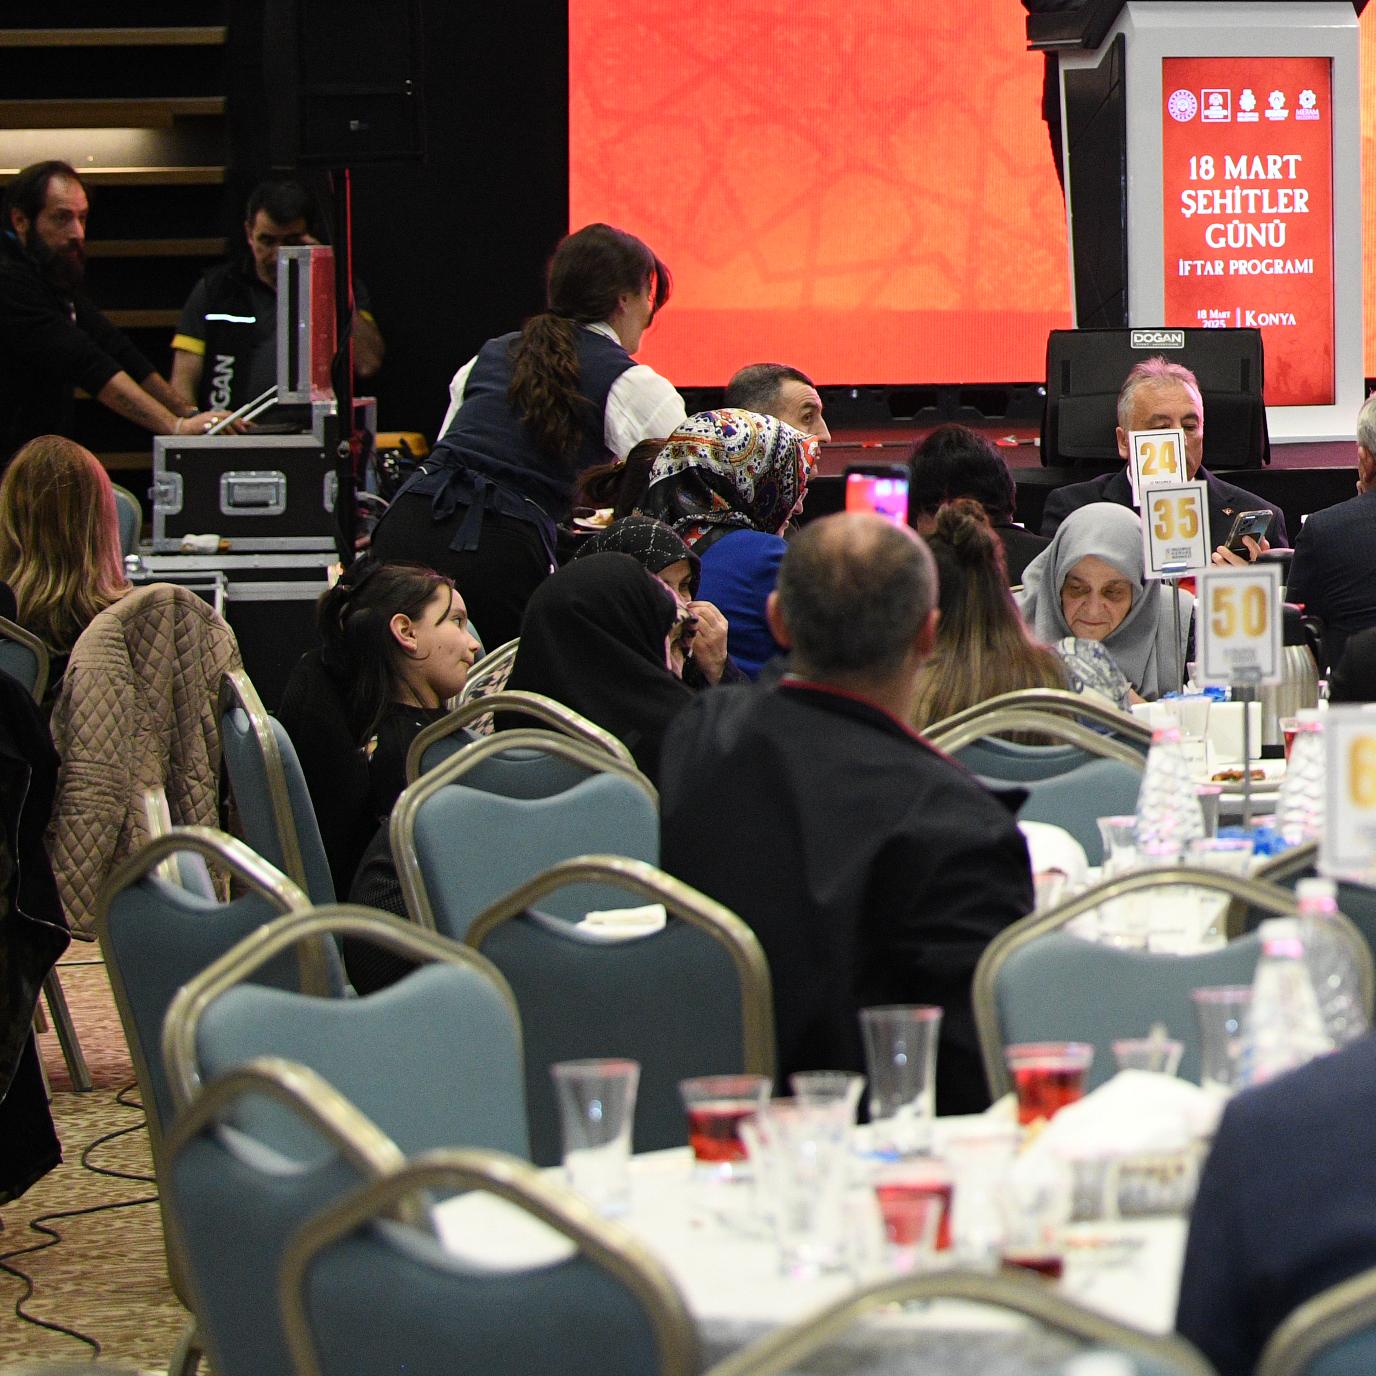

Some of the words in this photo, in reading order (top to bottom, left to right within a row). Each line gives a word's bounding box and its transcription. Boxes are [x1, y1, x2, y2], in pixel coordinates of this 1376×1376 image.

[1189, 155, 1215, 180] 18
[1224, 154, 1302, 180] MART
[1181, 185, 1309, 218] ŞEHİTLER
[1205, 219, 1286, 249] GÜNÜ
[1179, 258, 1224, 276] İFTAR
[1229, 258, 1314, 275] PROGRAMI
[1197, 309, 1207, 320] 18
[1202, 319, 1226, 328] 2025
[1245, 310, 1297, 327] KONYA
[1133, 332, 1182, 343] DOĞAN
[210, 354, 235, 412] GAN
[1140, 441, 1177, 476] 24
[1153, 496, 1199, 541] 35
[1211, 585, 1268, 639] 50
